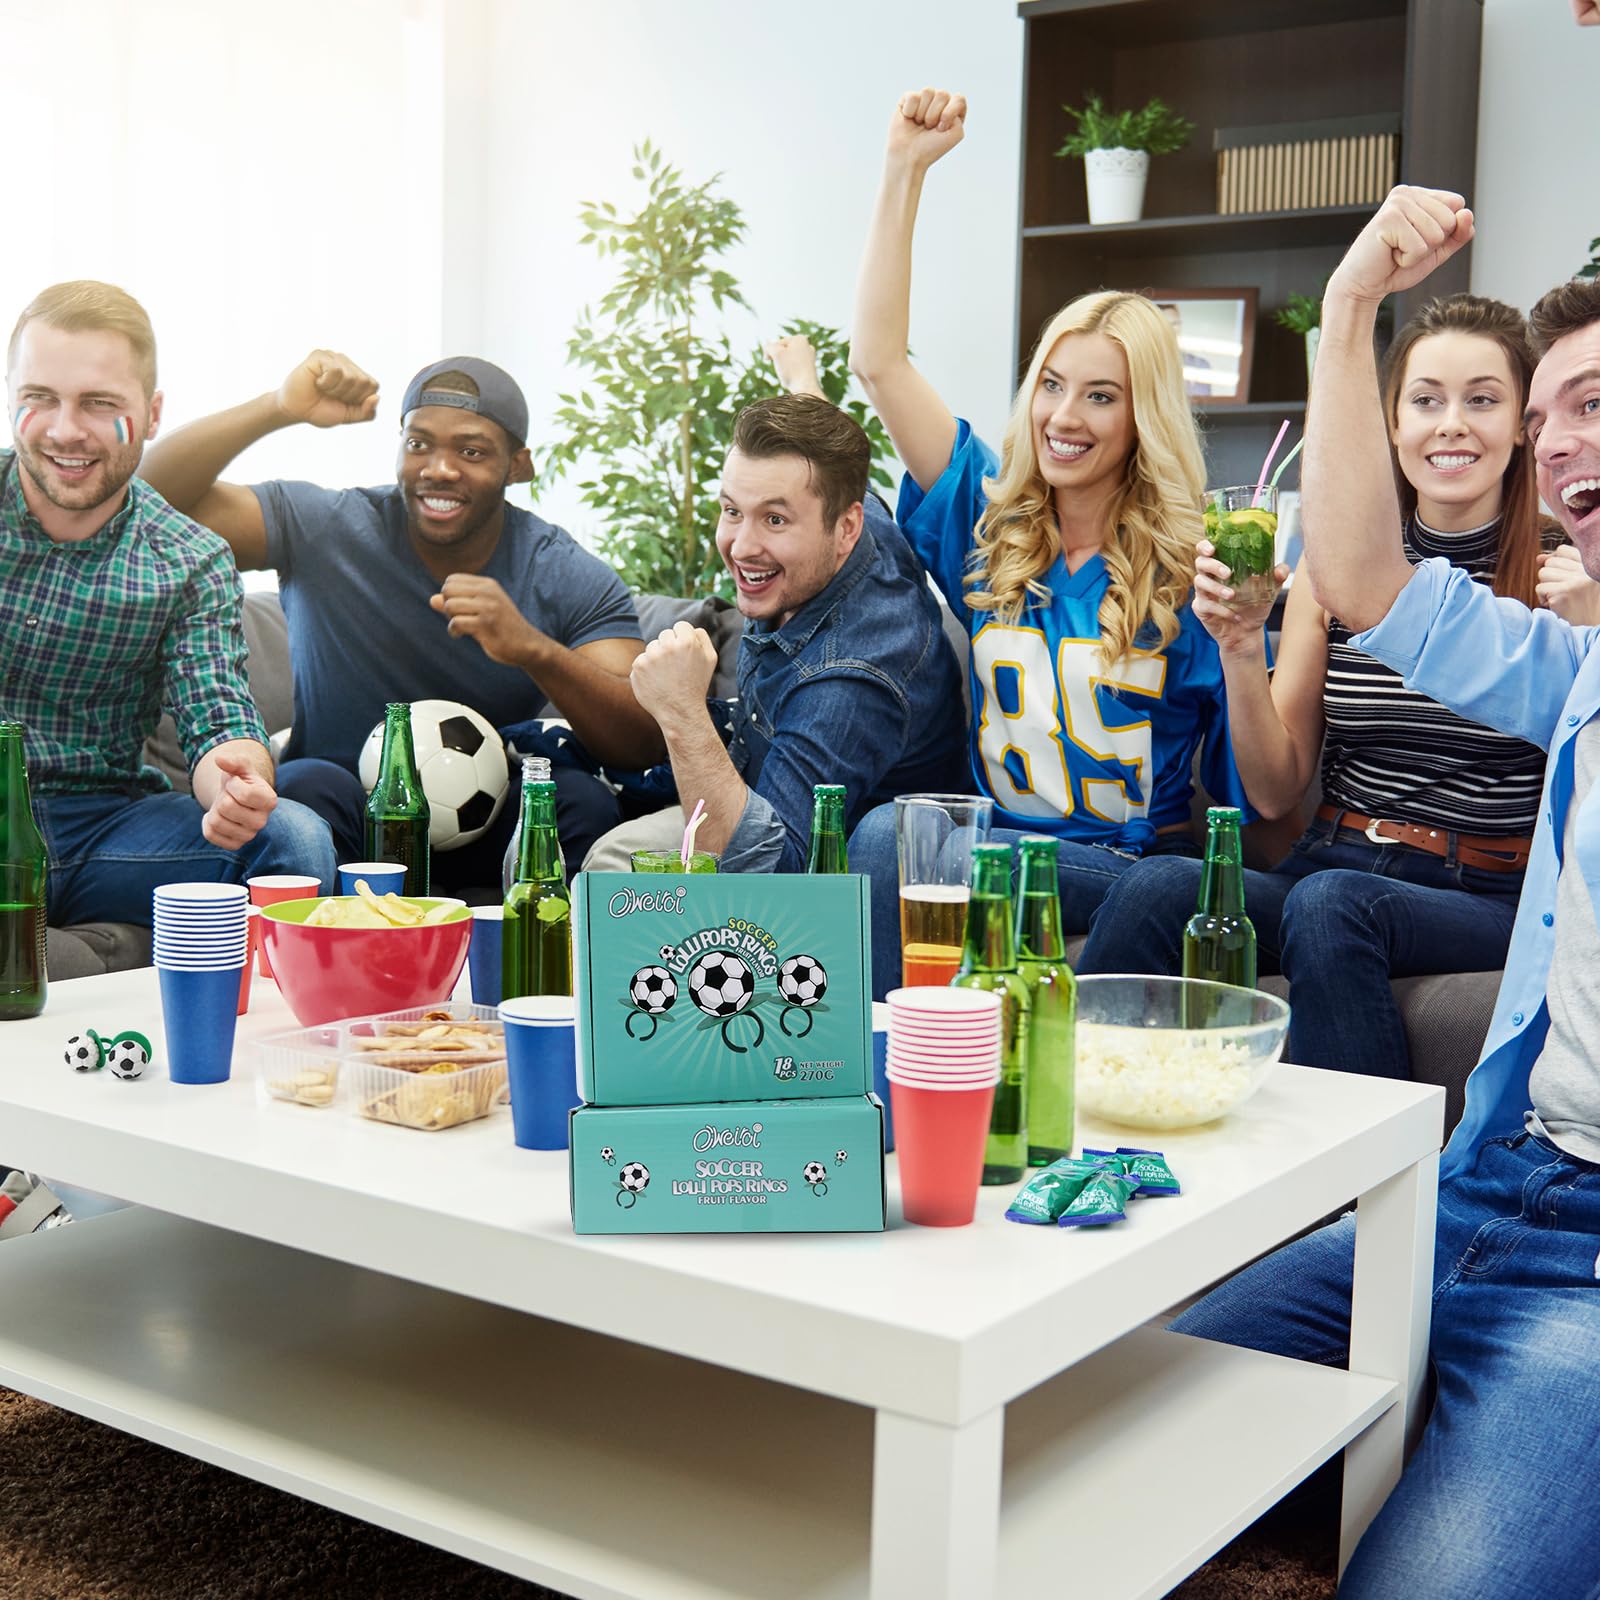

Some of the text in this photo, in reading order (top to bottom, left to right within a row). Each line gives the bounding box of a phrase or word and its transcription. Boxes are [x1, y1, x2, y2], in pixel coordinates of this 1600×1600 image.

[972, 624, 1167, 823] 85
[728, 918, 778, 952] SOCCER
[735, 947, 751, 961] FRUIT
[740, 934, 778, 976] RINGS
[775, 1057, 793, 1075] 18
[799, 1060, 844, 1069] NET WEIGHT
[780, 1070, 797, 1078] PCS
[800, 1070, 834, 1081] 270G
[695, 1159, 763, 1178] SOCCER
[710, 1179, 743, 1194] POPS
[745, 1179, 788, 1193] RINGS
[698, 1195, 767, 1205] FRUIT FLAVOR
